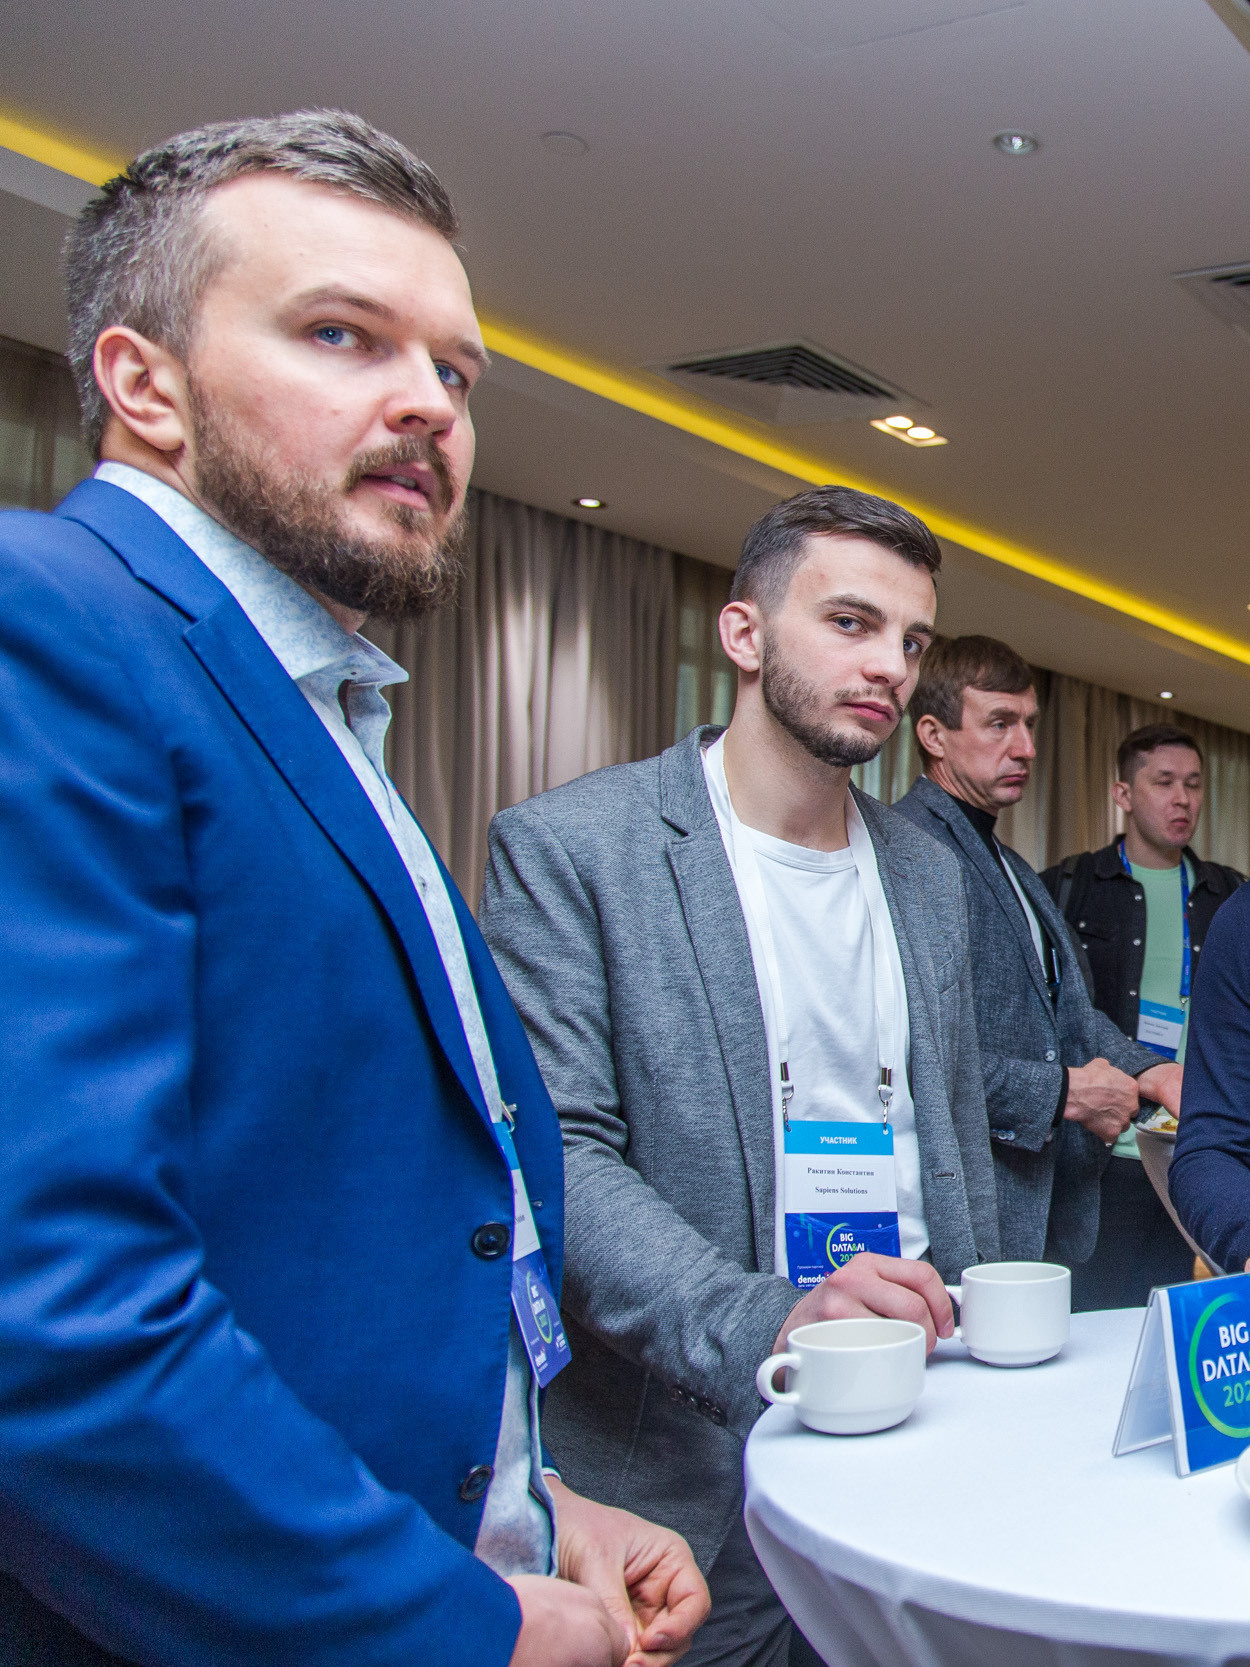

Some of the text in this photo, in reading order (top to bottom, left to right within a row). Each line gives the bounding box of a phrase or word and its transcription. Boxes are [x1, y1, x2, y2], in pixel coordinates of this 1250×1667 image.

[820, 1136, 857, 1144] УЧАСТНИК
[807, 1167, 875, 1176] Ракитин Константин
[815, 1186, 868, 1195] Sapiens Solutions
[840, 1233, 853, 1241] BIG
[832, 1243, 865, 1252] DATA&AI
[840, 1253, 856, 1262] 202
[798, 1274, 825, 1283] denodo
[1218, 1321, 1250, 1349] BIG
